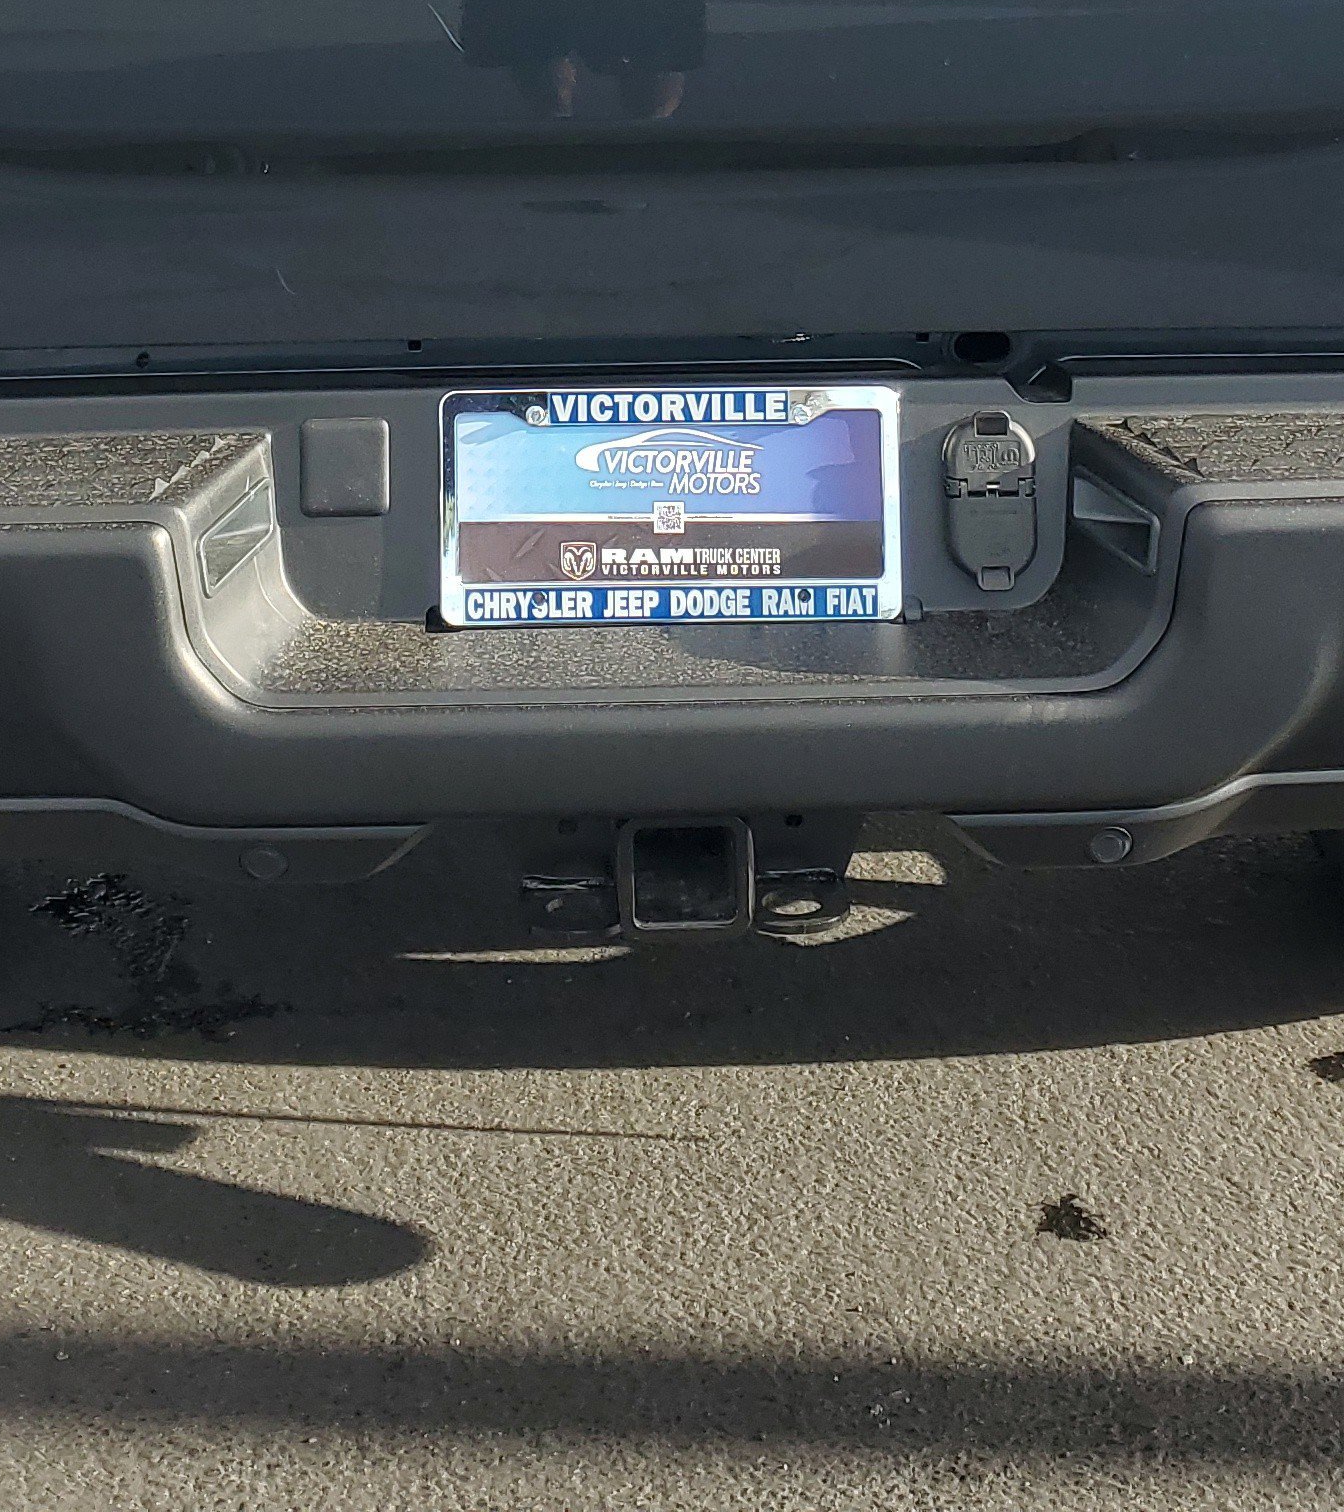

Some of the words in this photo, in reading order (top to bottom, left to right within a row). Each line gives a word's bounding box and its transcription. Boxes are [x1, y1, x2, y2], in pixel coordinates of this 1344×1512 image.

[551, 391, 787, 423] VICTORVILLE
[604, 450, 755, 474] VICTORVILLE
[668, 472, 761, 494] MOTORS
[601, 548, 693, 564] RAM
[695, 548, 732, 564] TRUCK
[735, 548, 781, 564] CENTER
[601, 564, 708, 575] VICTORVILLE
[717, 564, 781, 575] MOTORS
[467, 590, 594, 620] CHRYSLER
[603, 590, 660, 618] JEEP
[670, 589, 751, 617] DODGE
[762, 589, 816, 616] RAM
[826, 588, 876, 616] FIAT
